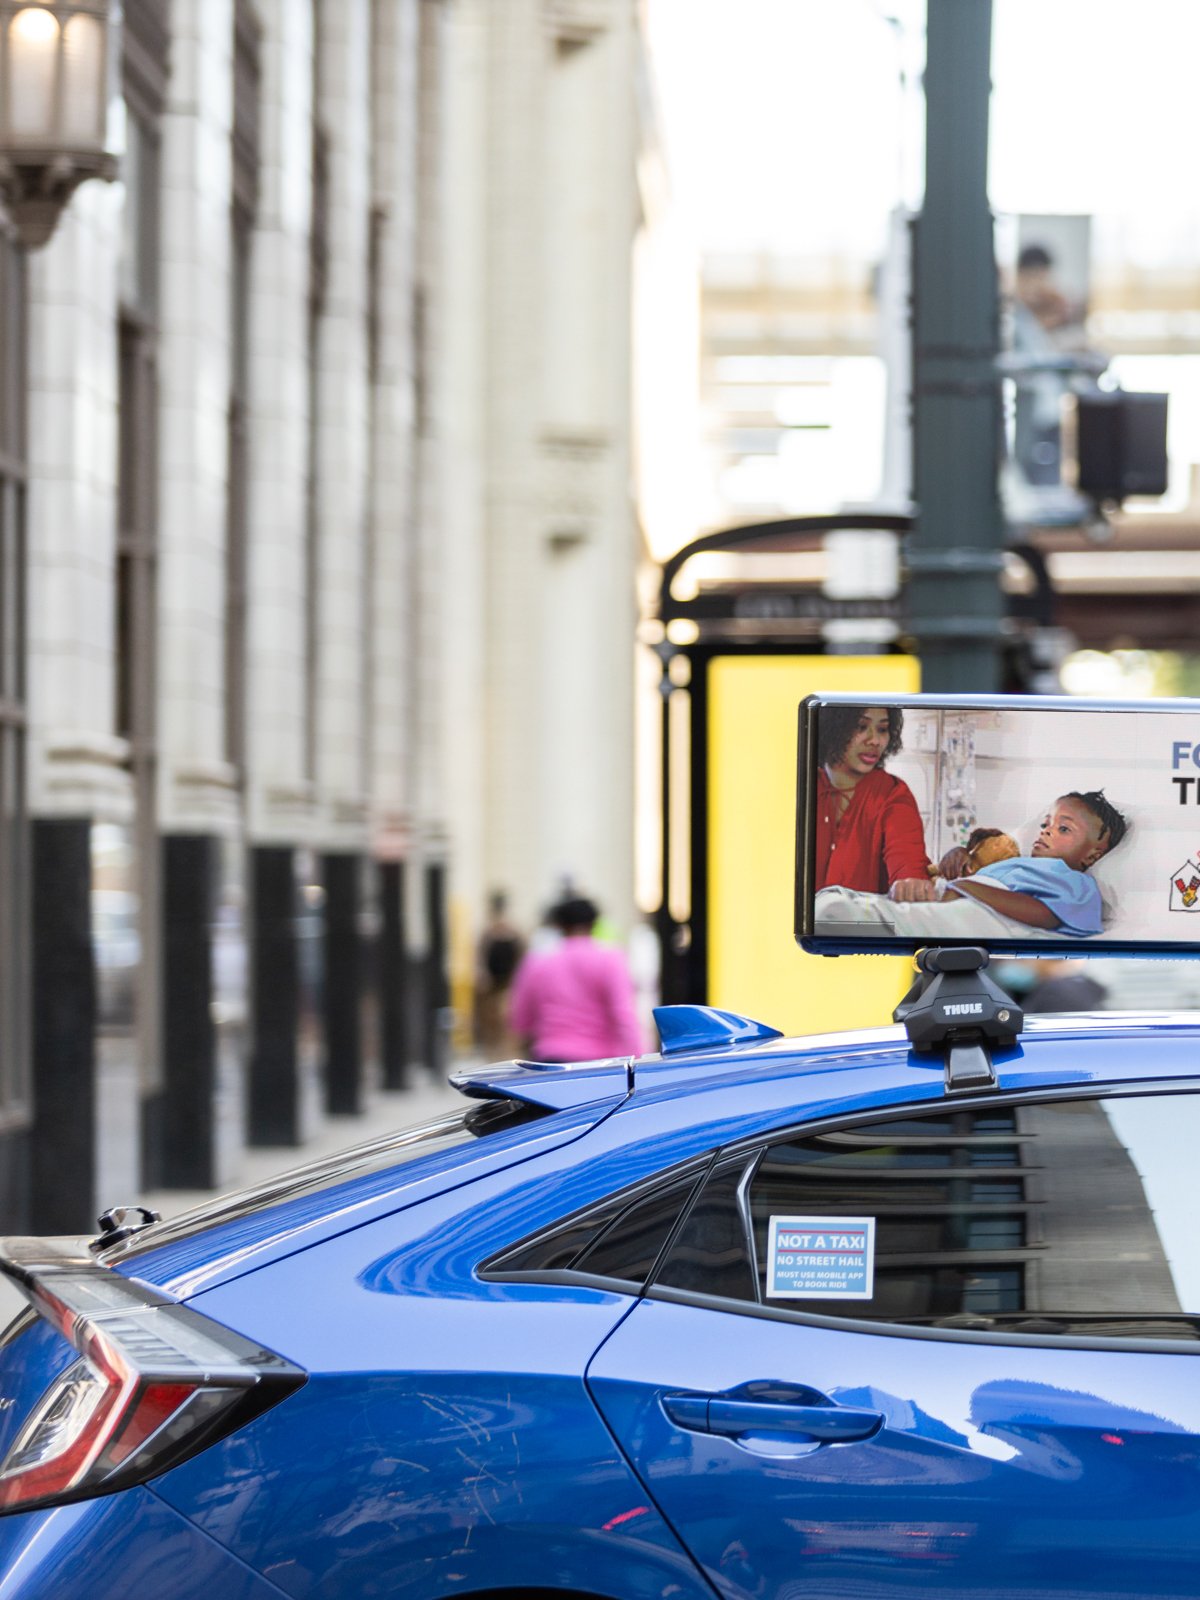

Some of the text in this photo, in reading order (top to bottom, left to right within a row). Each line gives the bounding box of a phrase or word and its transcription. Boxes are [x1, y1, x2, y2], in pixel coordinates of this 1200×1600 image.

[943, 1003, 983, 1016] THULE
[778, 1235, 864, 1249] NOT A TAXI
[777, 1256, 864, 1266] NO STREET HAIL
